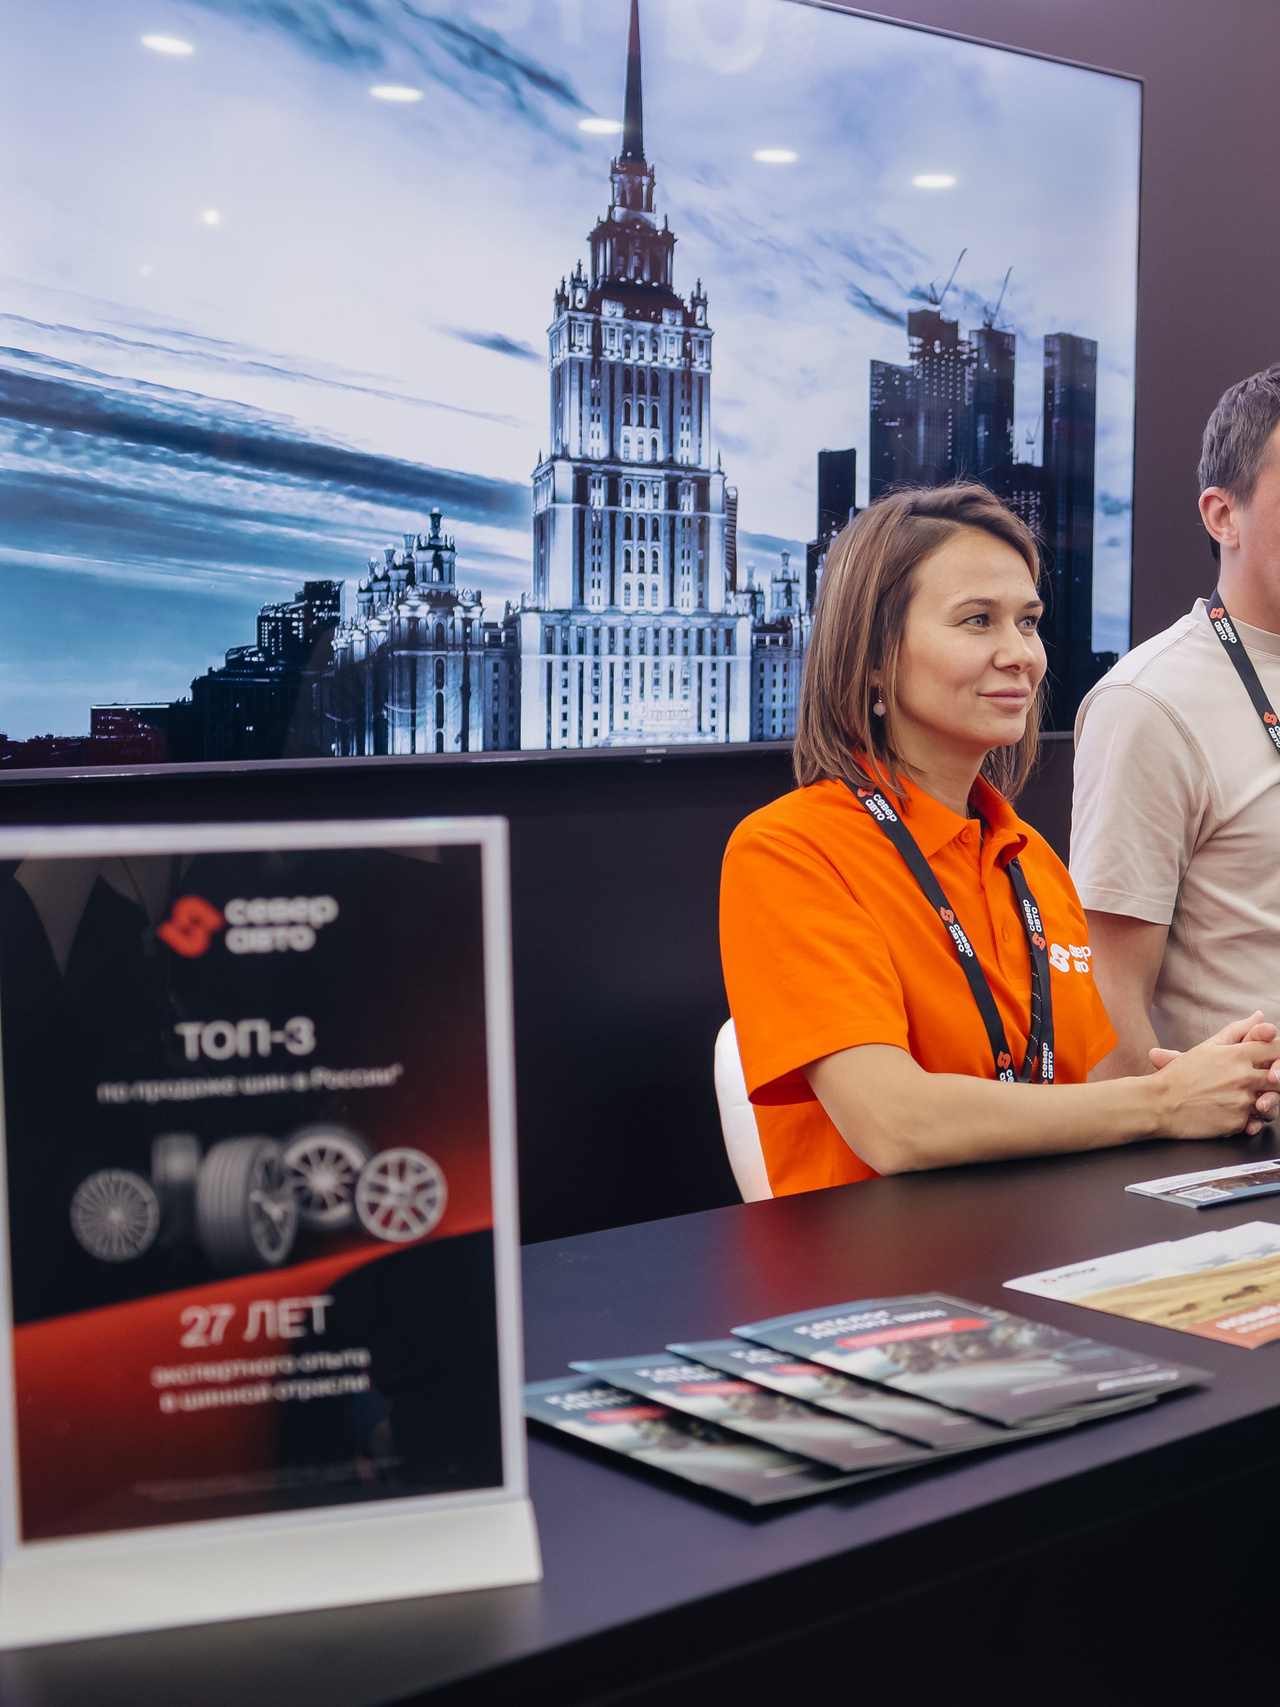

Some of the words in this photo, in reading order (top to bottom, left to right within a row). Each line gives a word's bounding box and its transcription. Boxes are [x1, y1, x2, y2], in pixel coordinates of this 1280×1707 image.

[1214, 621, 1228, 641] авто
[1221, 617, 1237, 643] север
[865, 799, 885, 821] авто
[873, 794, 897, 822] север
[224, 896, 339, 928] север
[1023, 899, 1035, 931] север
[1032, 906, 1042, 932] авто
[225, 925, 316, 955] авто
[949, 925, 964, 952] авто
[953, 924, 973, 957] север
[174, 1015, 316, 1061] ТОП-3
[179, 1303, 237, 1348] 27
[242, 1294, 335, 1343] ЛЕТ
